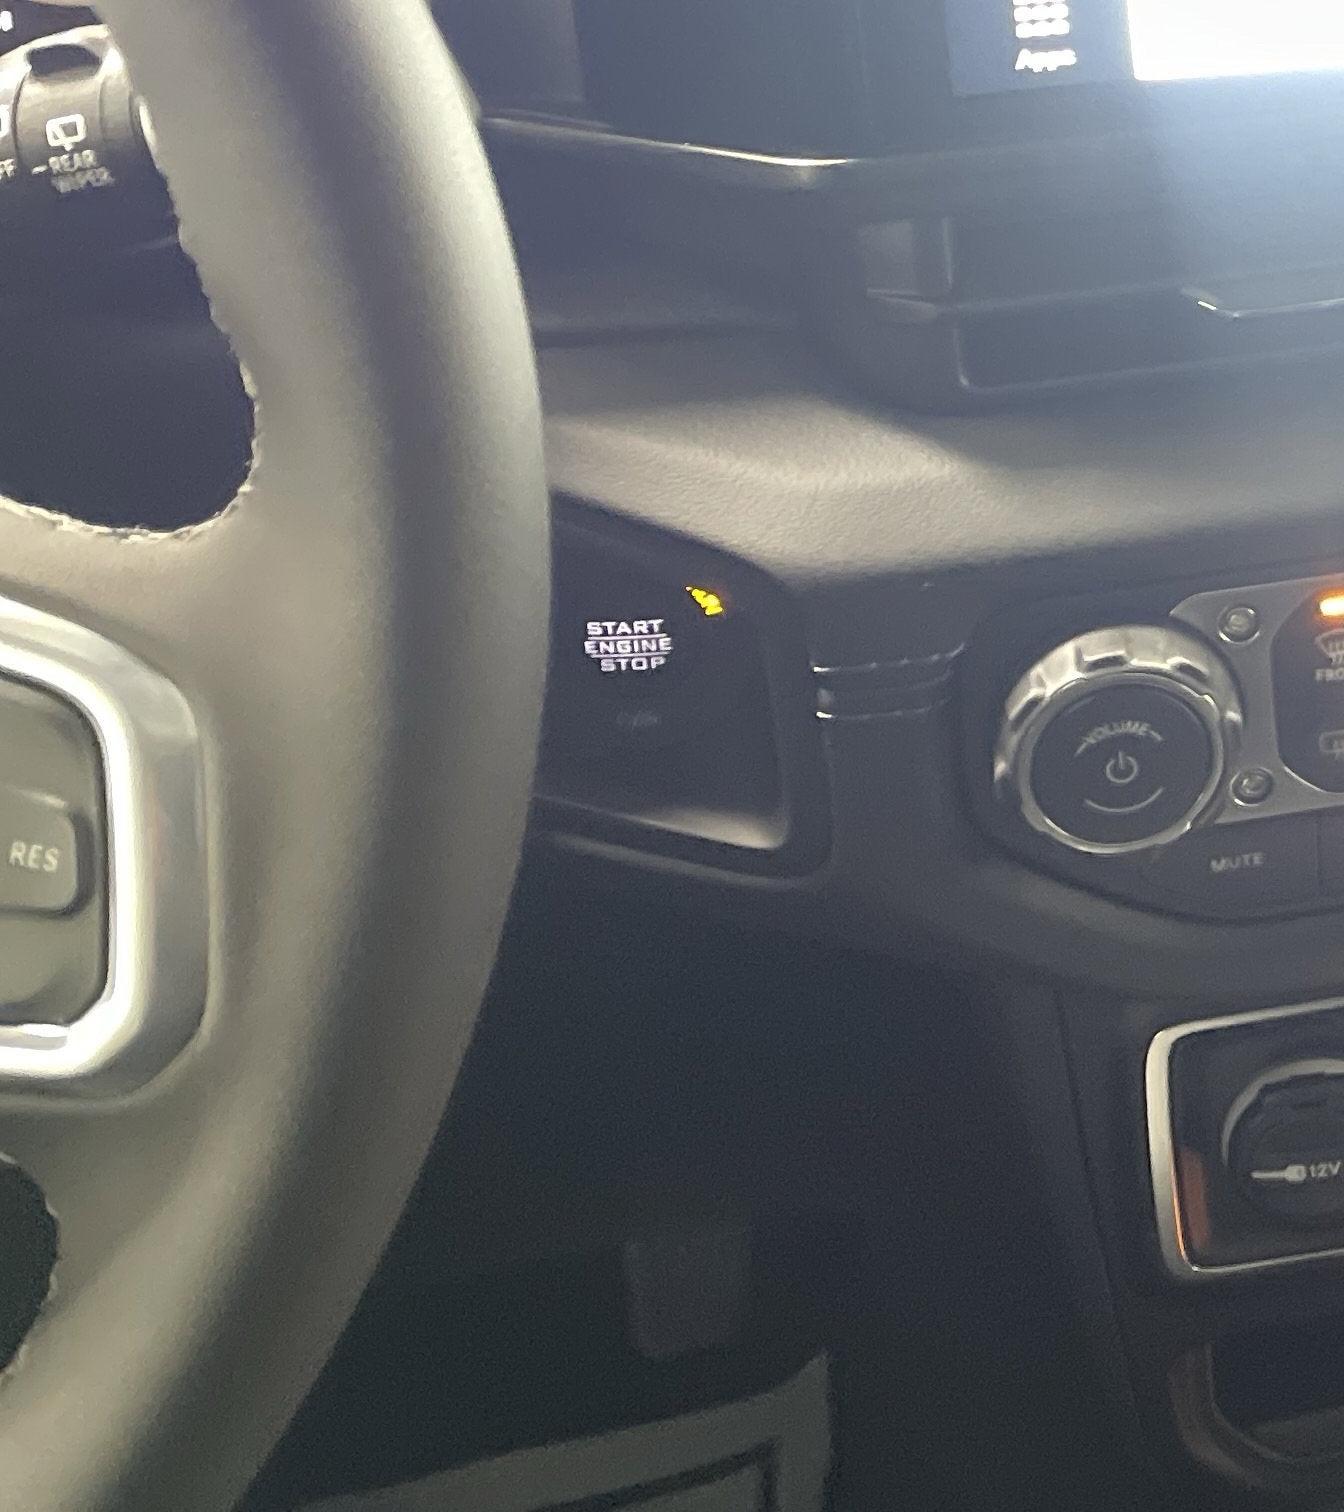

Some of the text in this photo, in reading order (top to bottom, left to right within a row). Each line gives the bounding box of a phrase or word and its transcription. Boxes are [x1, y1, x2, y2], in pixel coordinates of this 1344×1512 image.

[48, 149, 97, 175] REAR
[586, 618, 665, 636] START
[584, 637, 674, 655] ENGINE
[600, 656, 666, 673] STOP
[1085, 720, 1150, 745] VOLUME
[9, 841, 60, 873] RES
[1210, 851, 1266, 873] MUTE
[1308, 1161, 1341, 1179] 12V
